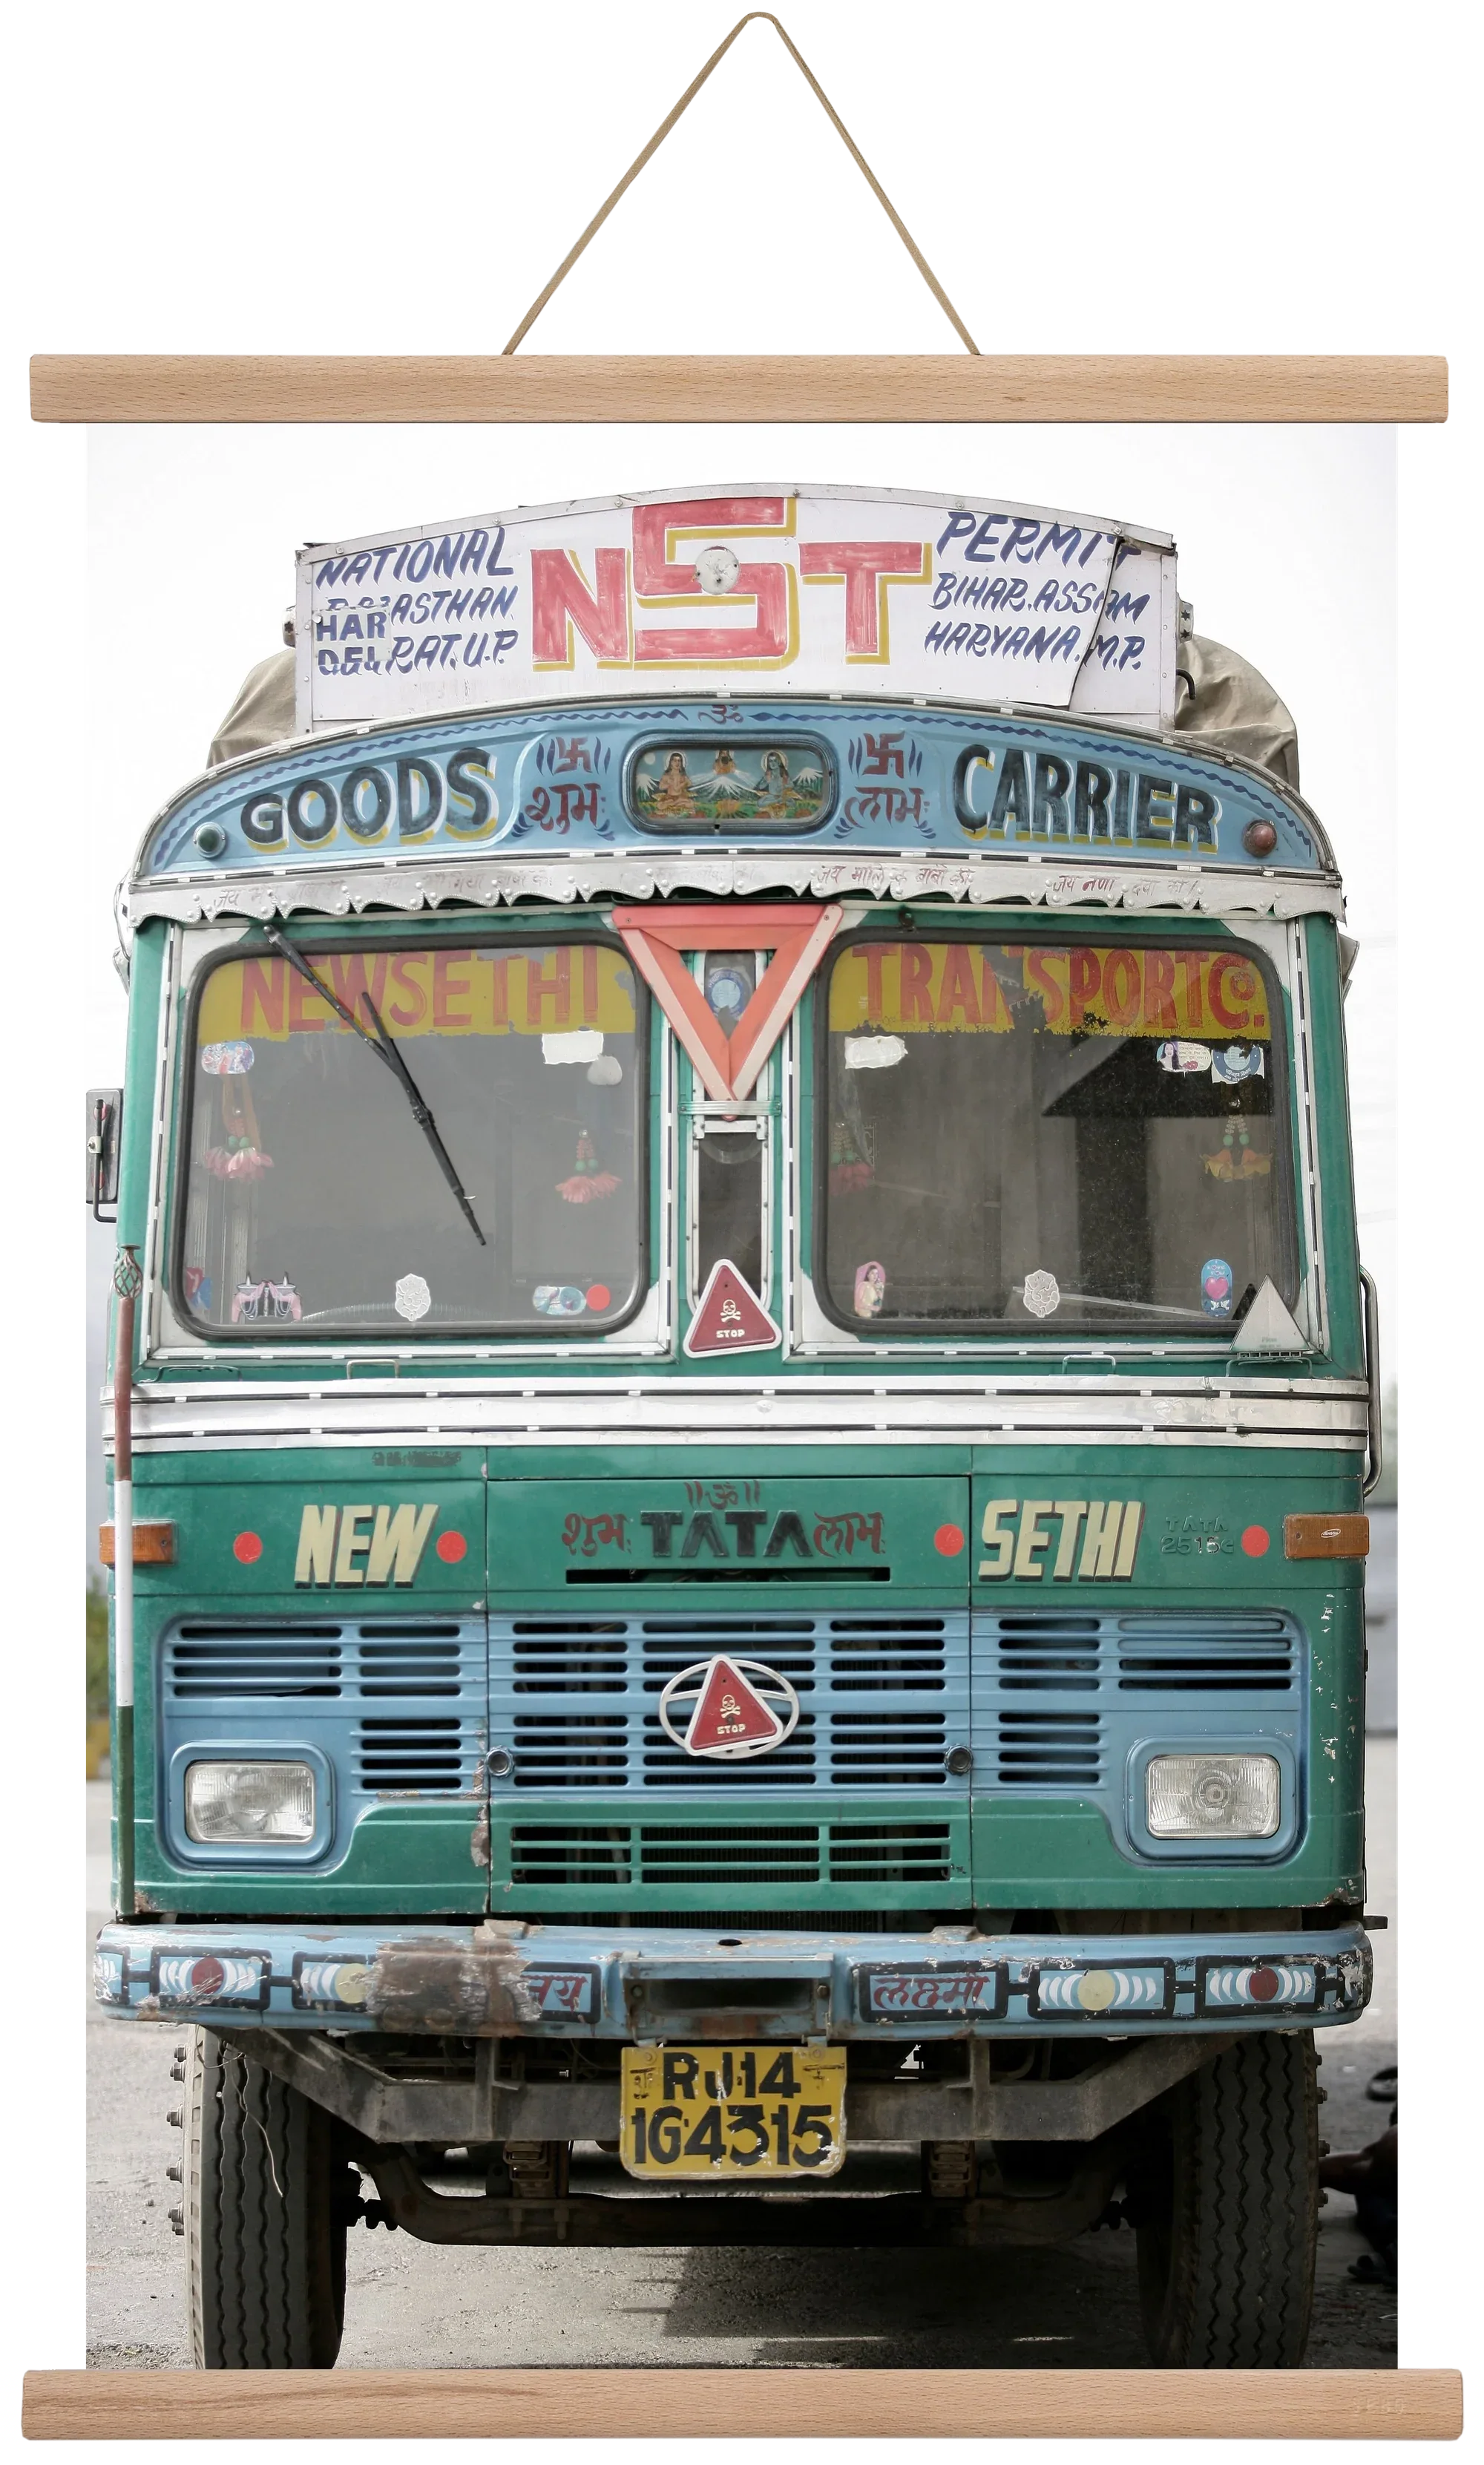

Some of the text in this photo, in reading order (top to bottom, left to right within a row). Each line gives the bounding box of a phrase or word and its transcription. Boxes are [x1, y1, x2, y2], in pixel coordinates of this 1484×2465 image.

[316, 526, 514, 589] NATIONAL
[936, 511, 1142, 571] PERMIT
[531, 497, 932, 671] NST
[317, 611, 388, 641] HAR
[241, 744, 1223, 854] GOODS CARRIER
[716, 1329, 746, 1339] STOP
[295, 1504, 441, 1588] NEW
[640, 1510, 814, 1558] TATA
[977, 1499, 1146, 1582] SETHI
[1166, 1515, 1229, 1533] TATA
[717, 1723, 746, 1735] STOP
